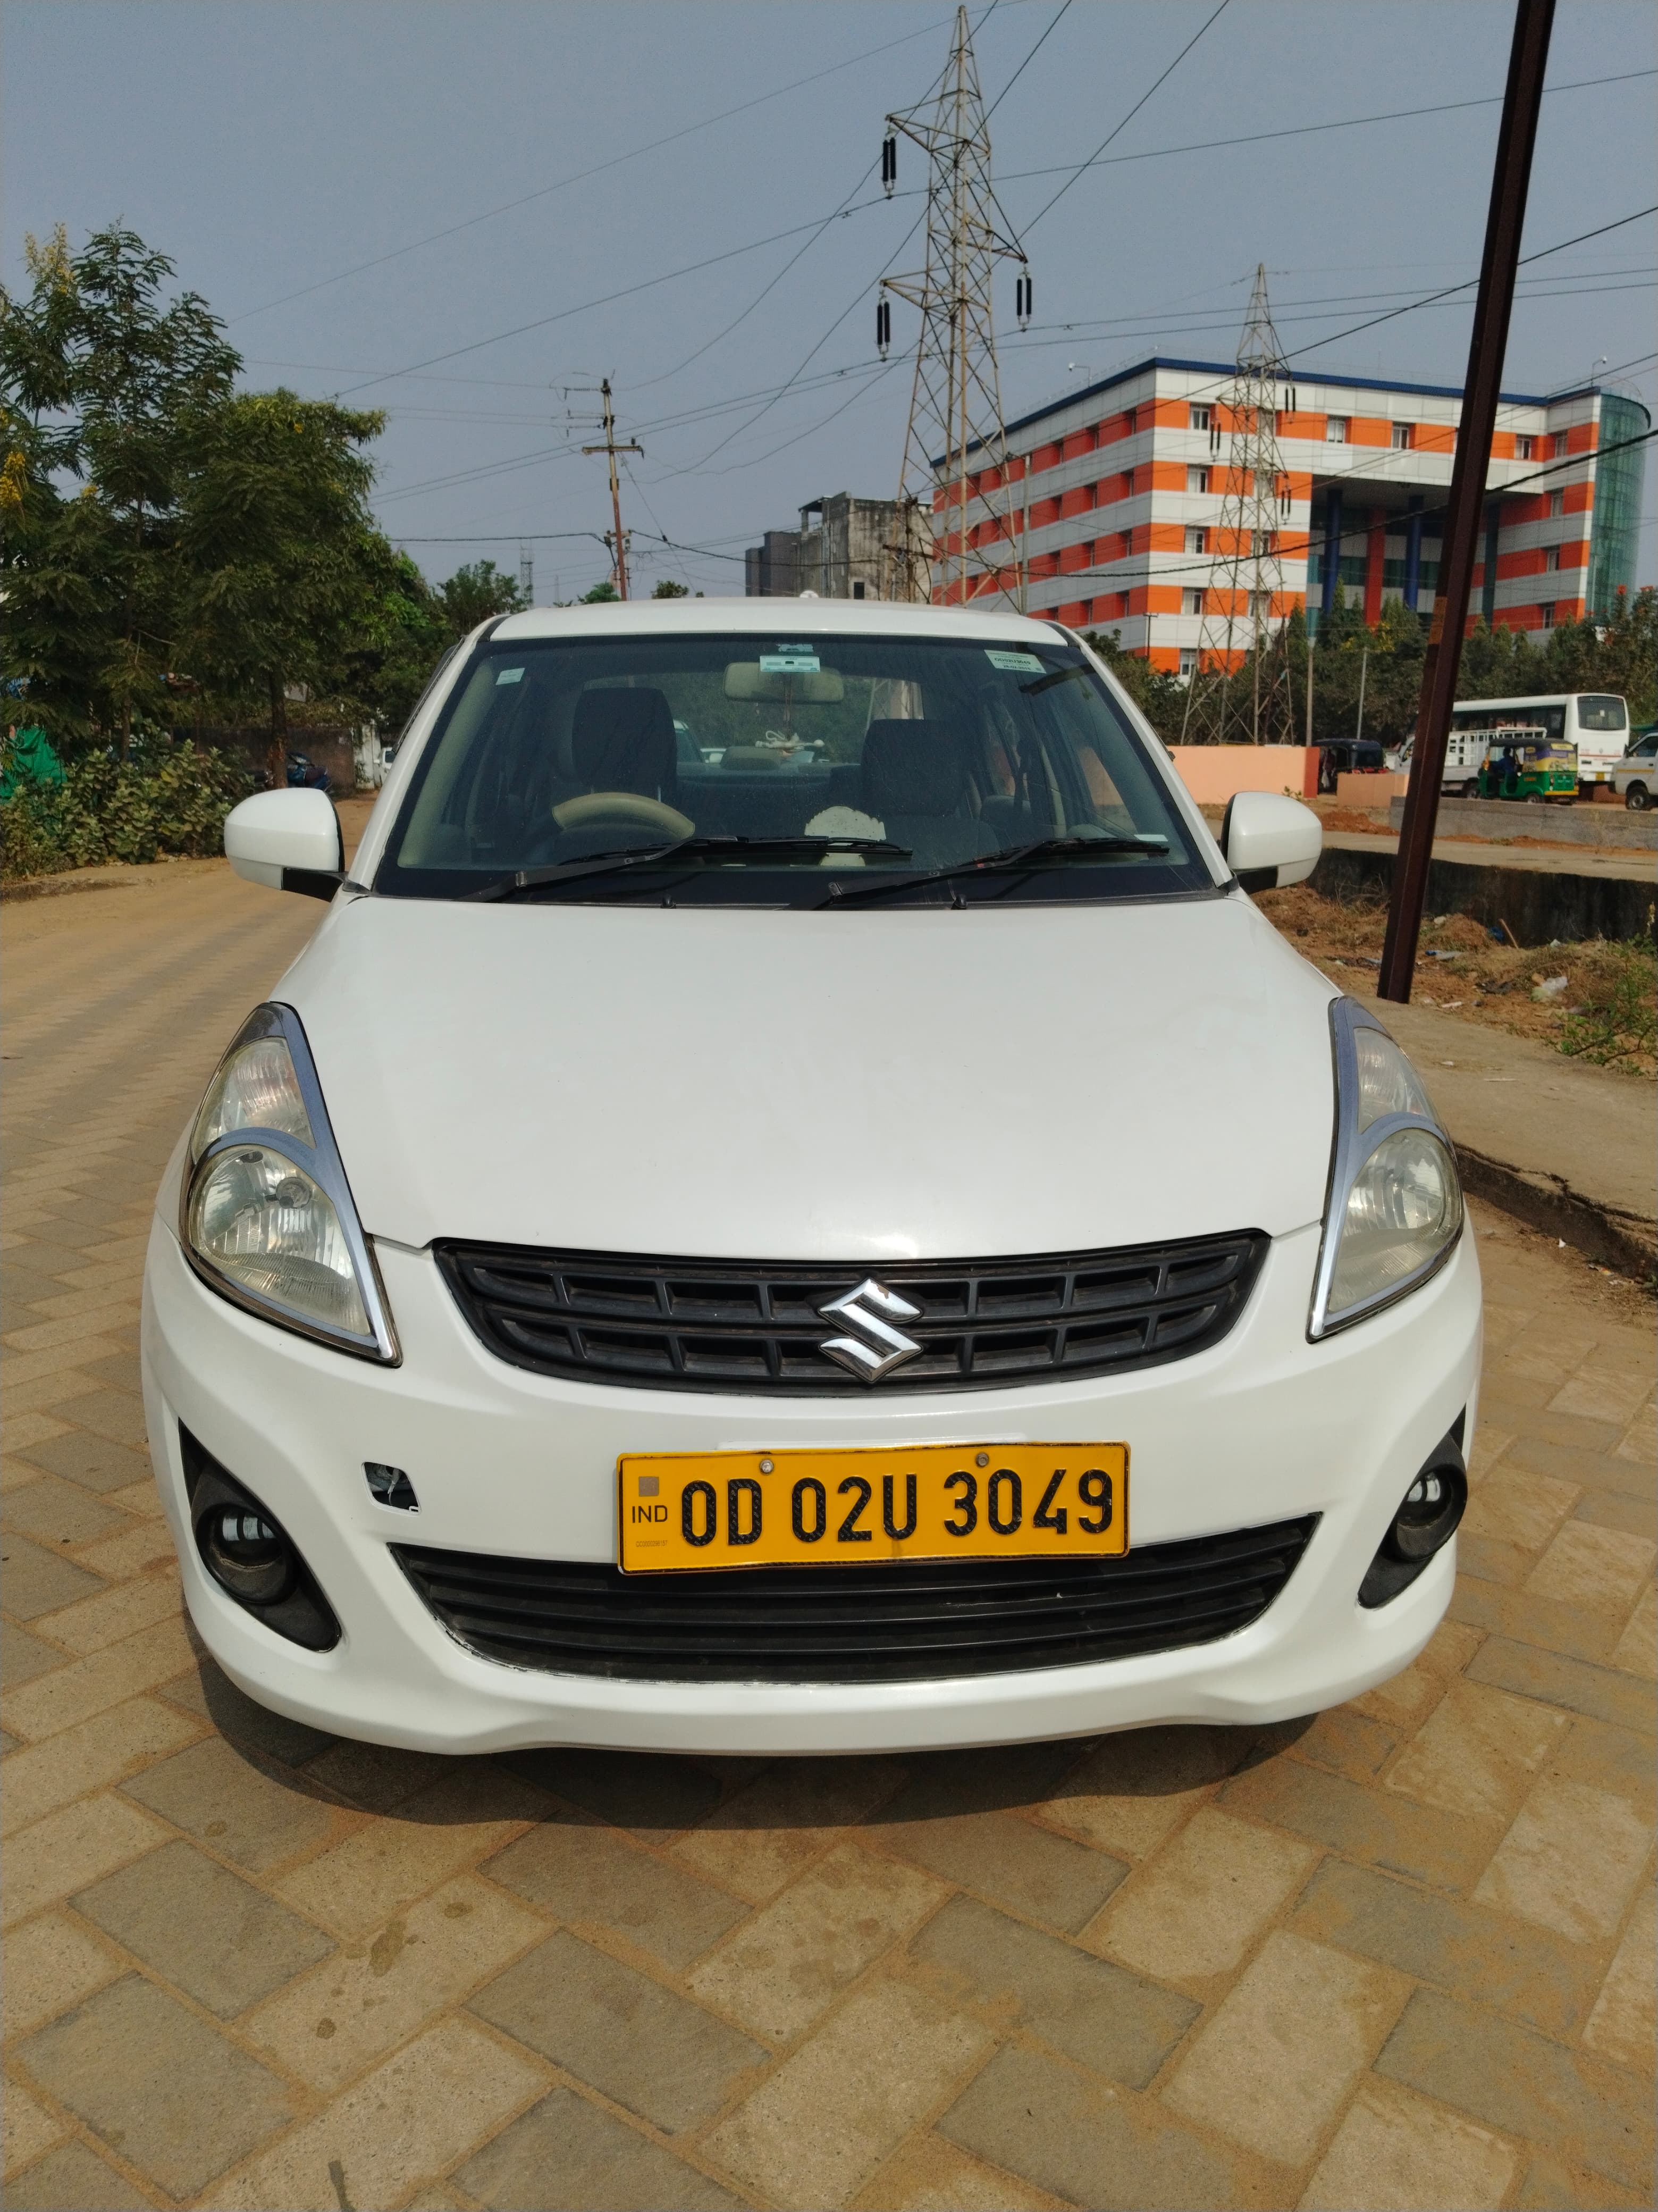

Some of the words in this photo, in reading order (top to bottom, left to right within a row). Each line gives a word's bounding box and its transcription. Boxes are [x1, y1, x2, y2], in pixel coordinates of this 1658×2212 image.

[632, 1505, 668, 1523] IND
[681, 1478, 763, 1546] OD
[792, 1473, 917, 1542] 02U
[944, 1469, 1113, 1536] 3049
